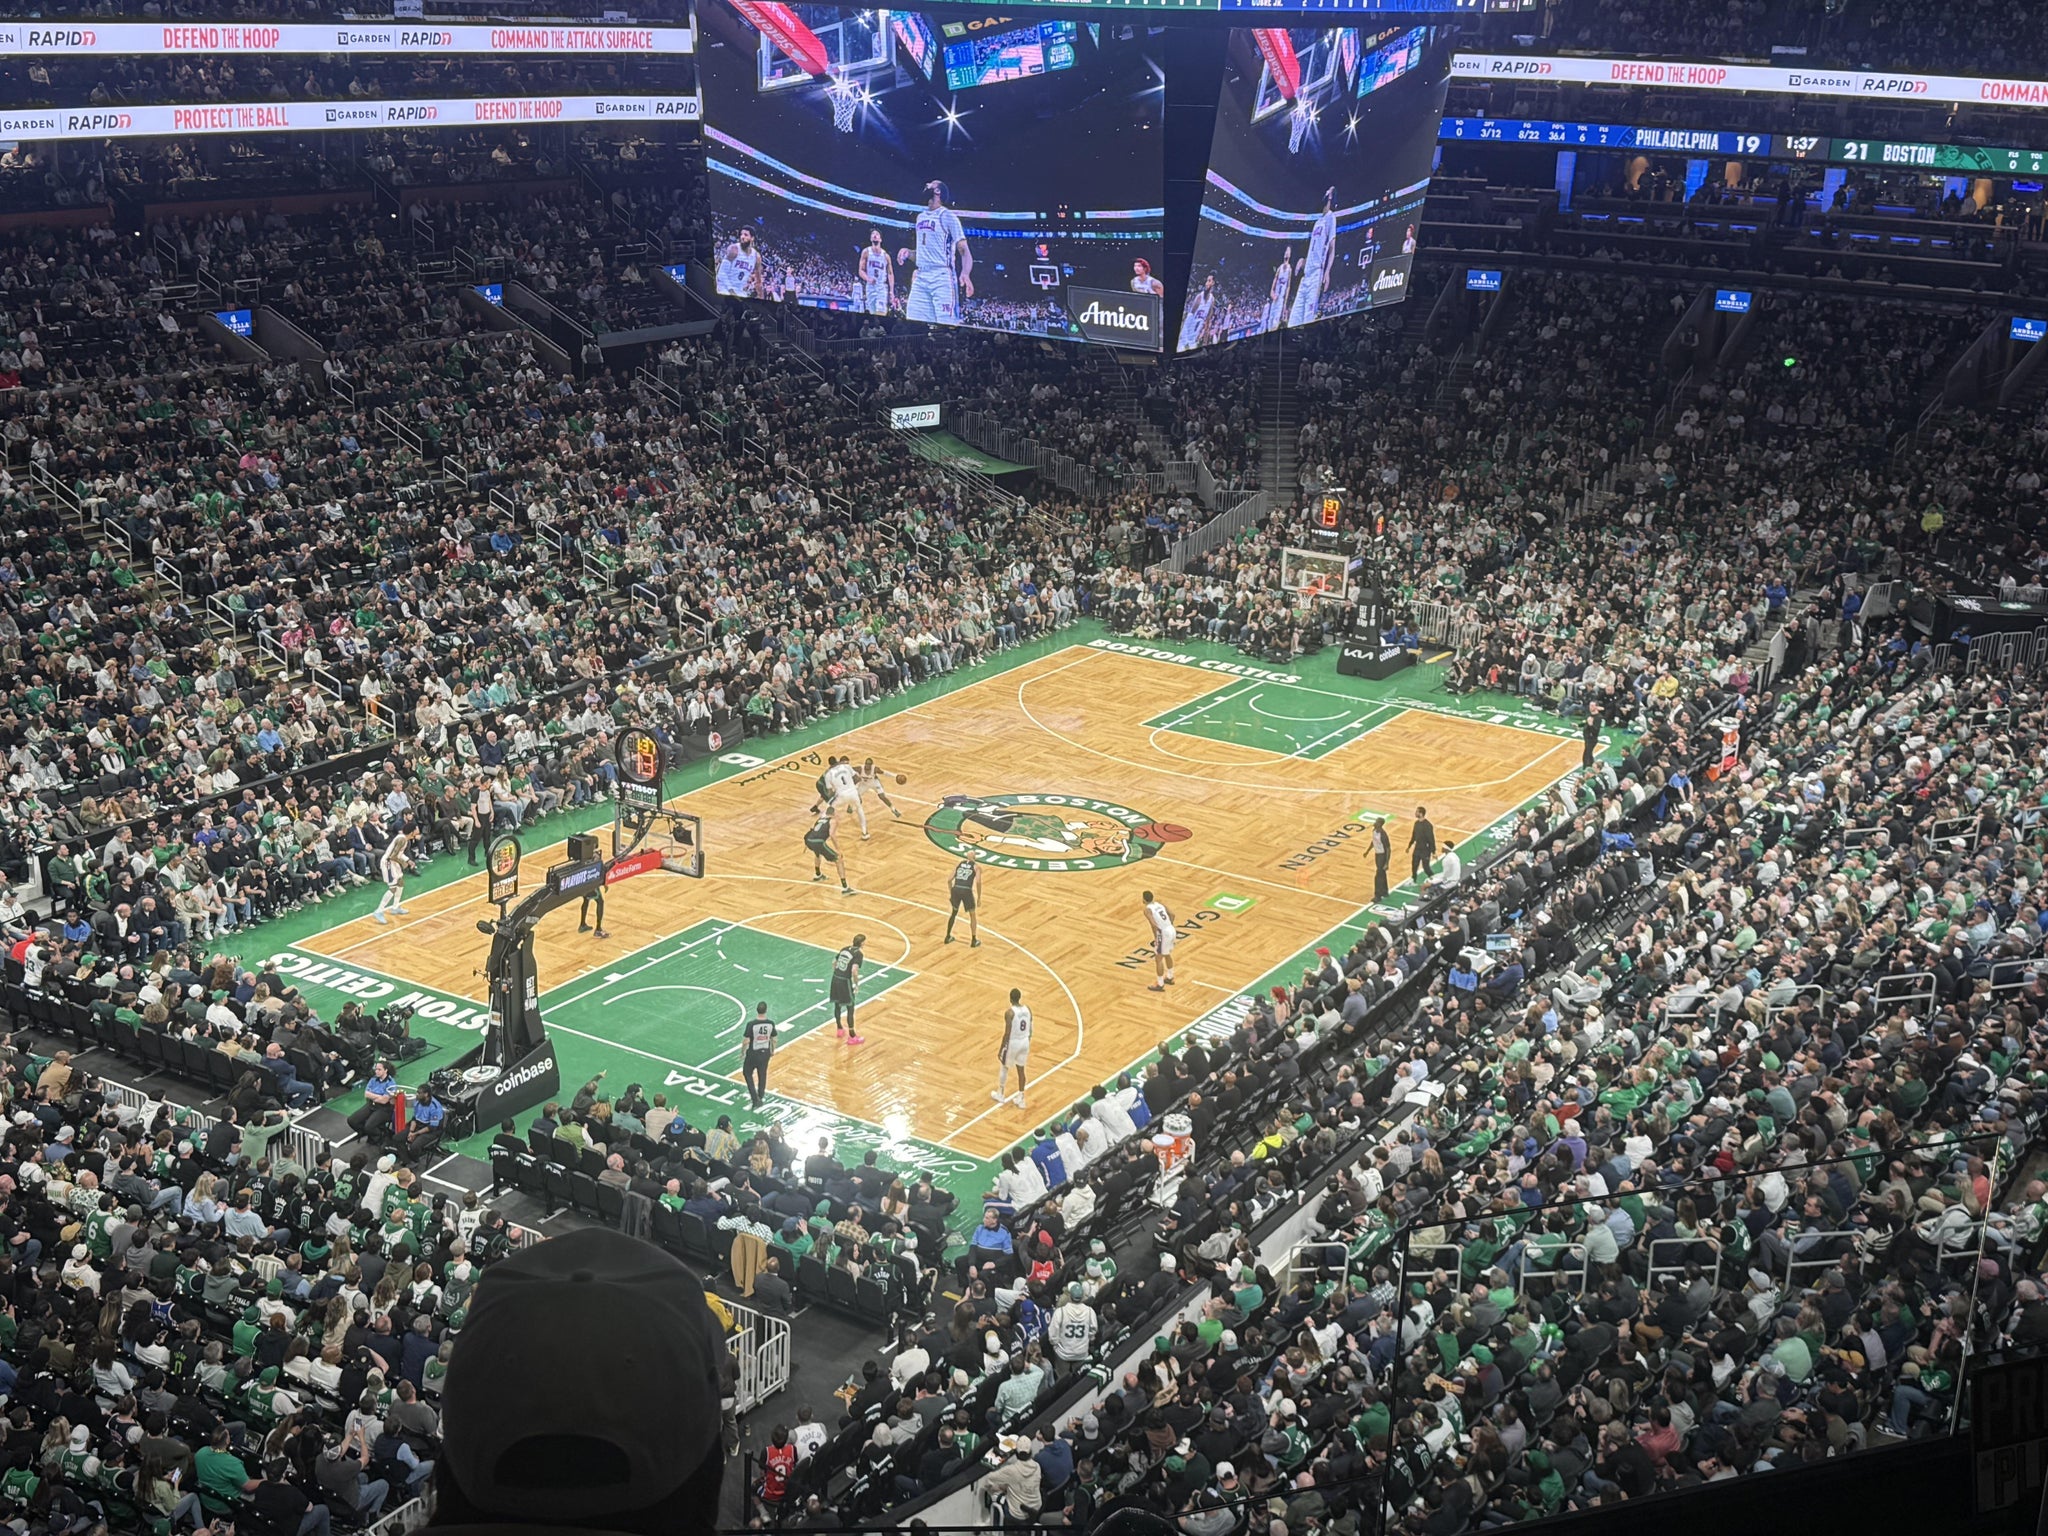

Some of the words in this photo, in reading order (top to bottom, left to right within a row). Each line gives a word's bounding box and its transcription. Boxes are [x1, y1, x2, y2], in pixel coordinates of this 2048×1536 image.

[163, 28, 219, 49] DEFEND
[221, 29, 241, 49] THE
[242, 28, 280, 48] HOOP
[350, 33, 391, 44] GARDEN
[491, 30, 549, 49] COMMAND
[550, 30, 565, 48] THE
[566, 30, 605, 49] ATTACK
[606, 31, 653, 49] SURFACE
[1611, 63, 1663, 81] DEFEND
[1666, 65, 1685, 83] THE
[1687, 66, 1727, 85] HOOP
[1803, 77, 1851, 87] GARDEN
[337, 109, 378, 121] GARDEN
[475, 102, 517, 121] DEFEND
[518, 101, 534, 120] THE
[534, 100, 562, 119] HOOP
[605, 103, 645, 114] GARDEN
[3, 119, 55, 130] GARDEN
[174, 108, 234, 130] PROTECT
[235, 107, 255, 128] THE
[256, 106, 289, 127] BALL
[1456, 127, 1463, 137] 0
[1480, 128, 1502, 138] 3/12
[1518, 129, 1540, 140] 8/22
[1549, 131, 1566, 141] 36.4
[1579, 132, 1586, 142] 6
[1600, 133, 1607, 143] 2
[1635, 129, 1719, 151] PHILADELPHIA
[1736, 135, 1761, 153] 19
[1785, 136, 1819, 151] 1:37
[1843, 142, 1868, 160] 21
[1883, 144, 1936, 164] BOSTON
[2009, 159, 2016, 170] 0
[2032, 161, 2039, 171] 6
[1373, 268, 1405, 292] Amica
[1080, 301, 1150, 331] Amica
[1086, 638, 1198, 665] BOSTON
[1199, 659, 1304, 684] CELTICS
[841, 775, 847, 786] 1
[1015, 794, 1149, 825] BOSTON
[1278, 822, 1366, 872] GARDEN
[948, 842, 1096, 871] CELTICS
[1158, 909, 1167, 921] 5
[256, 952, 396, 999] CELTICS
[758, 1025, 768, 1035] 45
[1019, 1019, 1027, 1032] 8
[494, 1057, 553, 1097] coinbase
[251, 1190, 263, 1207] 0
[88, 1221, 98, 1240] 6
[462, 1226, 473, 1241] 7
[1064, 1324, 1086, 1339] 33
[174, 1360, 183, 1375] 0
